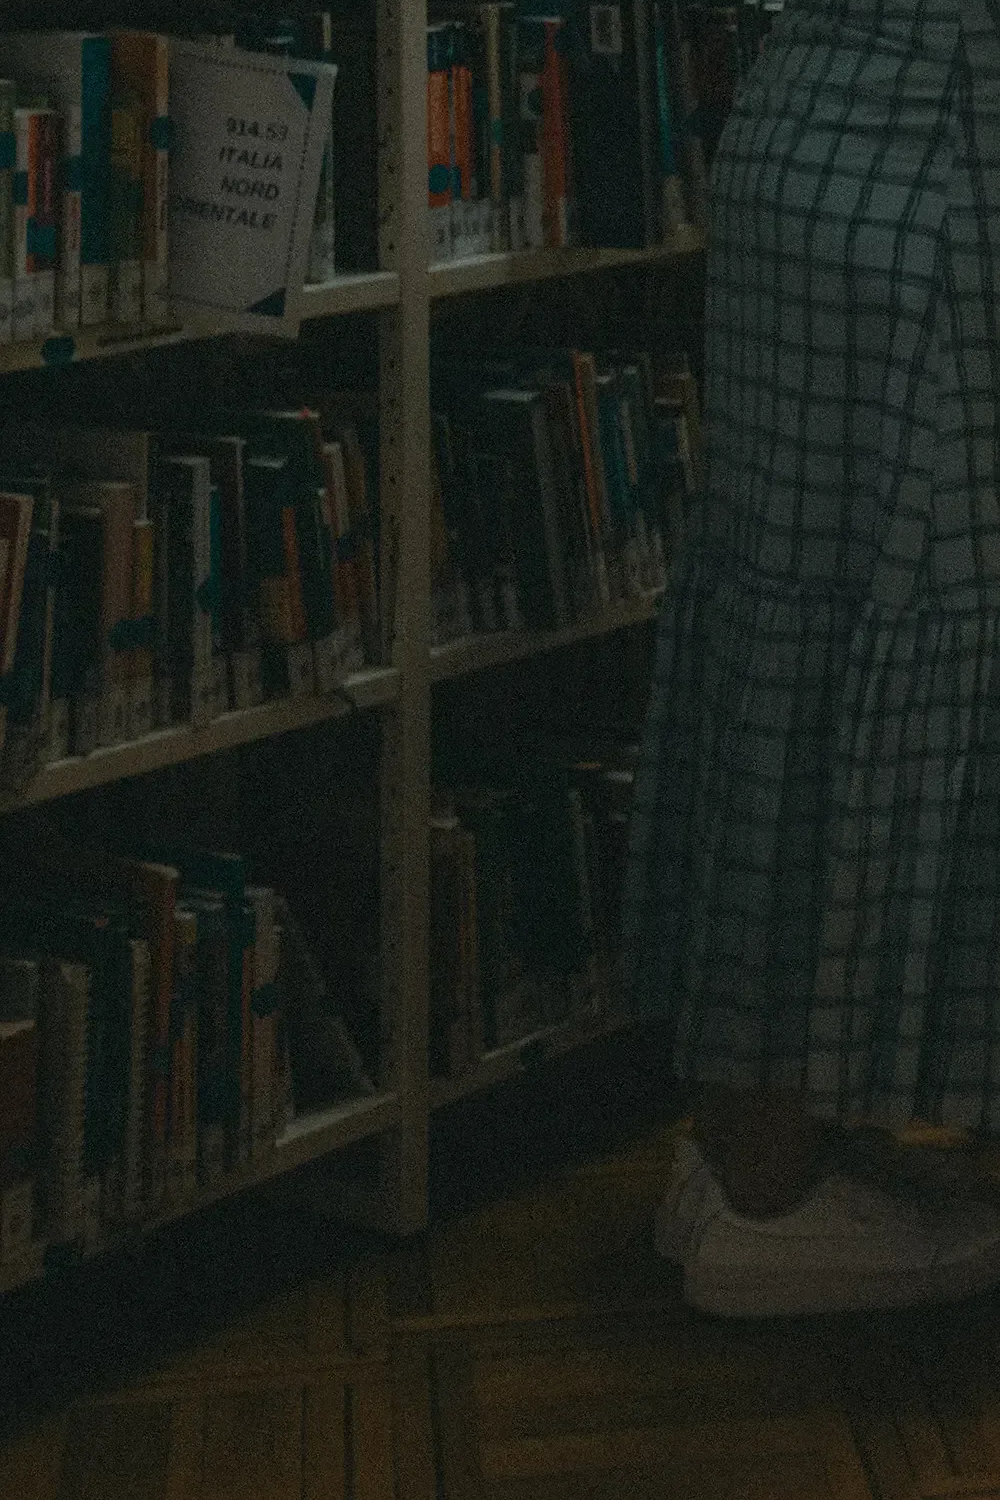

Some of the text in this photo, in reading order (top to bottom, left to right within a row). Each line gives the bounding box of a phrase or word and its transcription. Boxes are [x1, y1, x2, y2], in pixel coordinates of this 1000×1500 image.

[226, 116, 289, 142] 914.53
[218, 146, 283, 171] ITALIA
[220, 175, 281, 201] NORD
